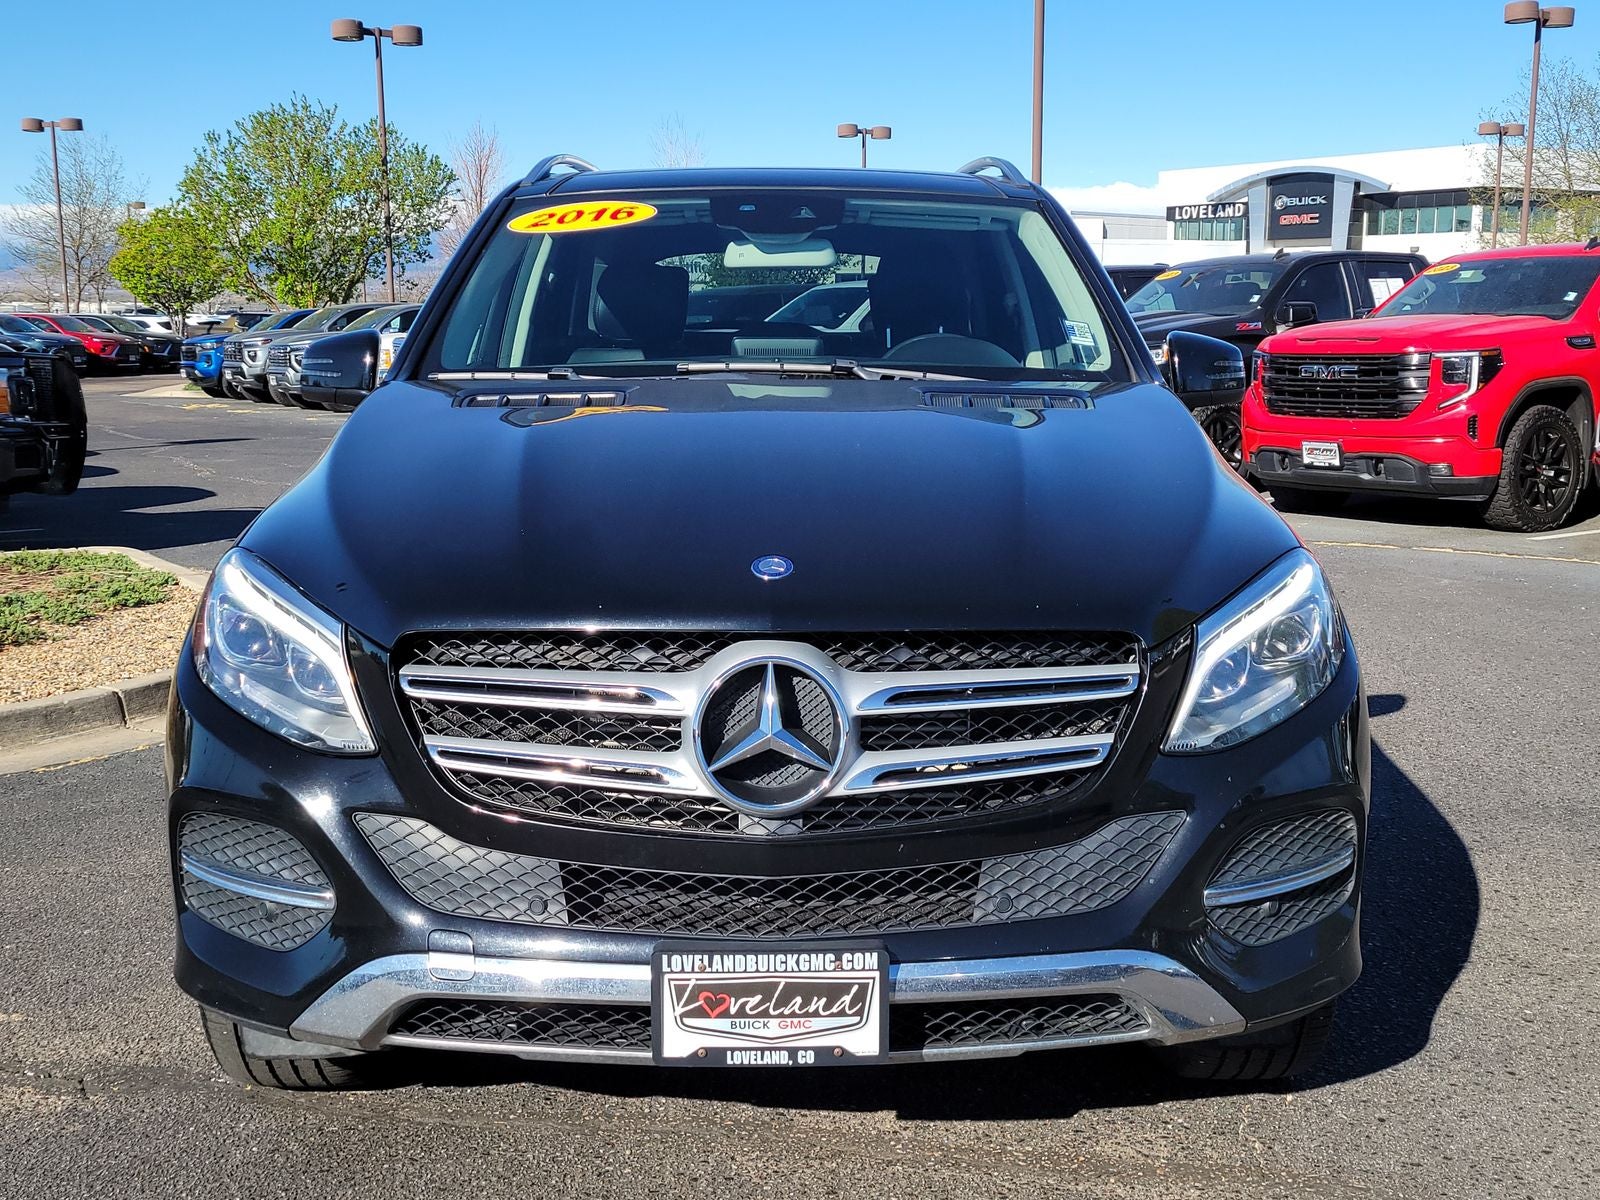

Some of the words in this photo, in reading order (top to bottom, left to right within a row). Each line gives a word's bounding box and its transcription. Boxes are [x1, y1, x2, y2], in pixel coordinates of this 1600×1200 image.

[1287, 195, 1328, 206] BUICK
[525, 206, 638, 228] 2016
[1174, 203, 1245, 220] LOVELAND
[1279, 213, 1320, 226] GMC
[1298, 364, 1361, 380] GMC
[730, 1020, 770, 1030] BUICK
[778, 1019, 812, 1029] GMC
[726, 1049, 793, 1065] LOVELAND,
[797, 1049, 815, 1064] CO
